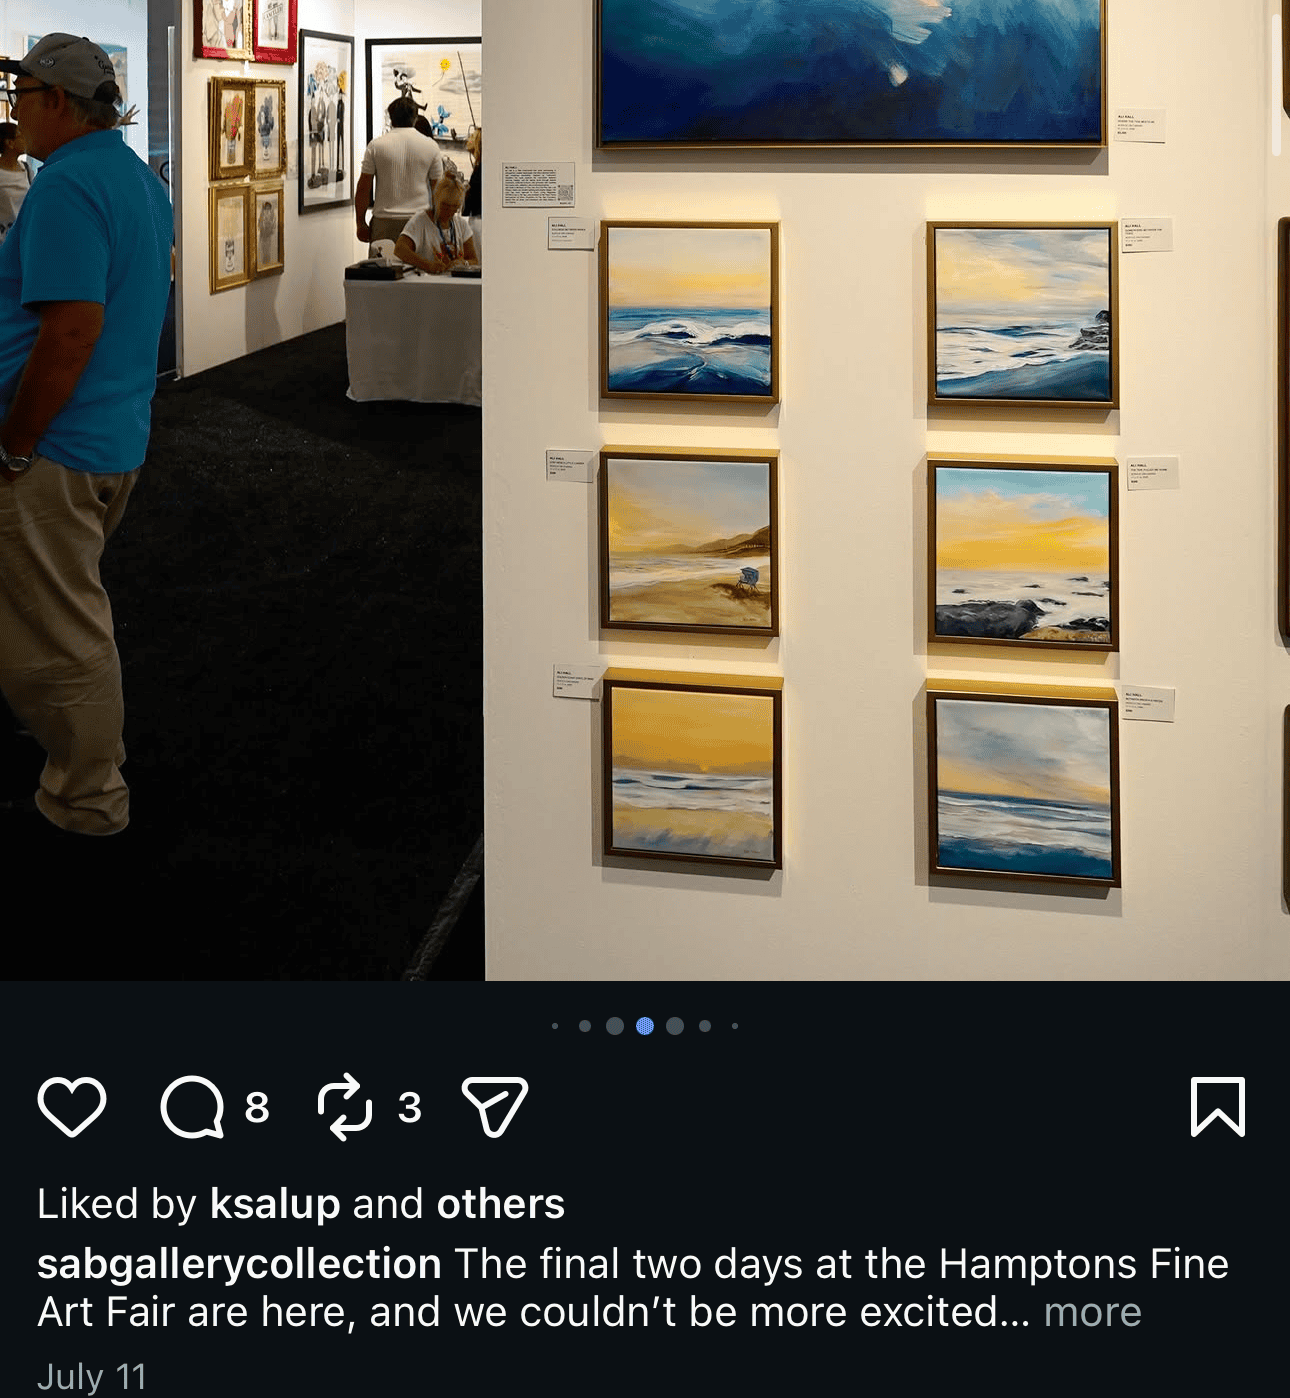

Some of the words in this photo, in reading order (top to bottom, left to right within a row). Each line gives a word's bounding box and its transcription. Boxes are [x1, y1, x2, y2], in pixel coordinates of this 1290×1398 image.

[244, 1091, 270, 1124] 8
[397, 1091, 422, 1124] 3
[38, 1186, 138, 1220] Liked
[152, 1186, 198, 1227] by
[211, 1186, 341, 1227] ksalup
[353, 1186, 423, 1220] and
[437, 1186, 565, 1220] others
[37, 1245, 441, 1287] sabgallerycollection
[454, 1246, 527, 1280] The
[539, 1246, 618, 1280] final
[632, 1249, 702, 1280] two
[714, 1246, 803, 1287] days
[816, 1249, 853, 1280] at
[864, 1246, 926, 1280] the
[940, 1247, 1137, 1287] Hamptons
[1151, 1246, 1229, 1280] Fine
[36, 1295, 94, 1327] Art
[107, 1294, 176, 1328] Fair
[188, 1302, 248, 1328] are
[262, 1294, 355, 1335] here,
[370, 1294, 440, 1328] and
[453, 1302, 507, 1328] we
[690, 1294, 737, 1328] be
[751, 1302, 847, 1328] more
[1045, 1302, 1142, 1328] more
[36, 1361, 105, 1397] July
[116, 1362, 145, 1390] 11
